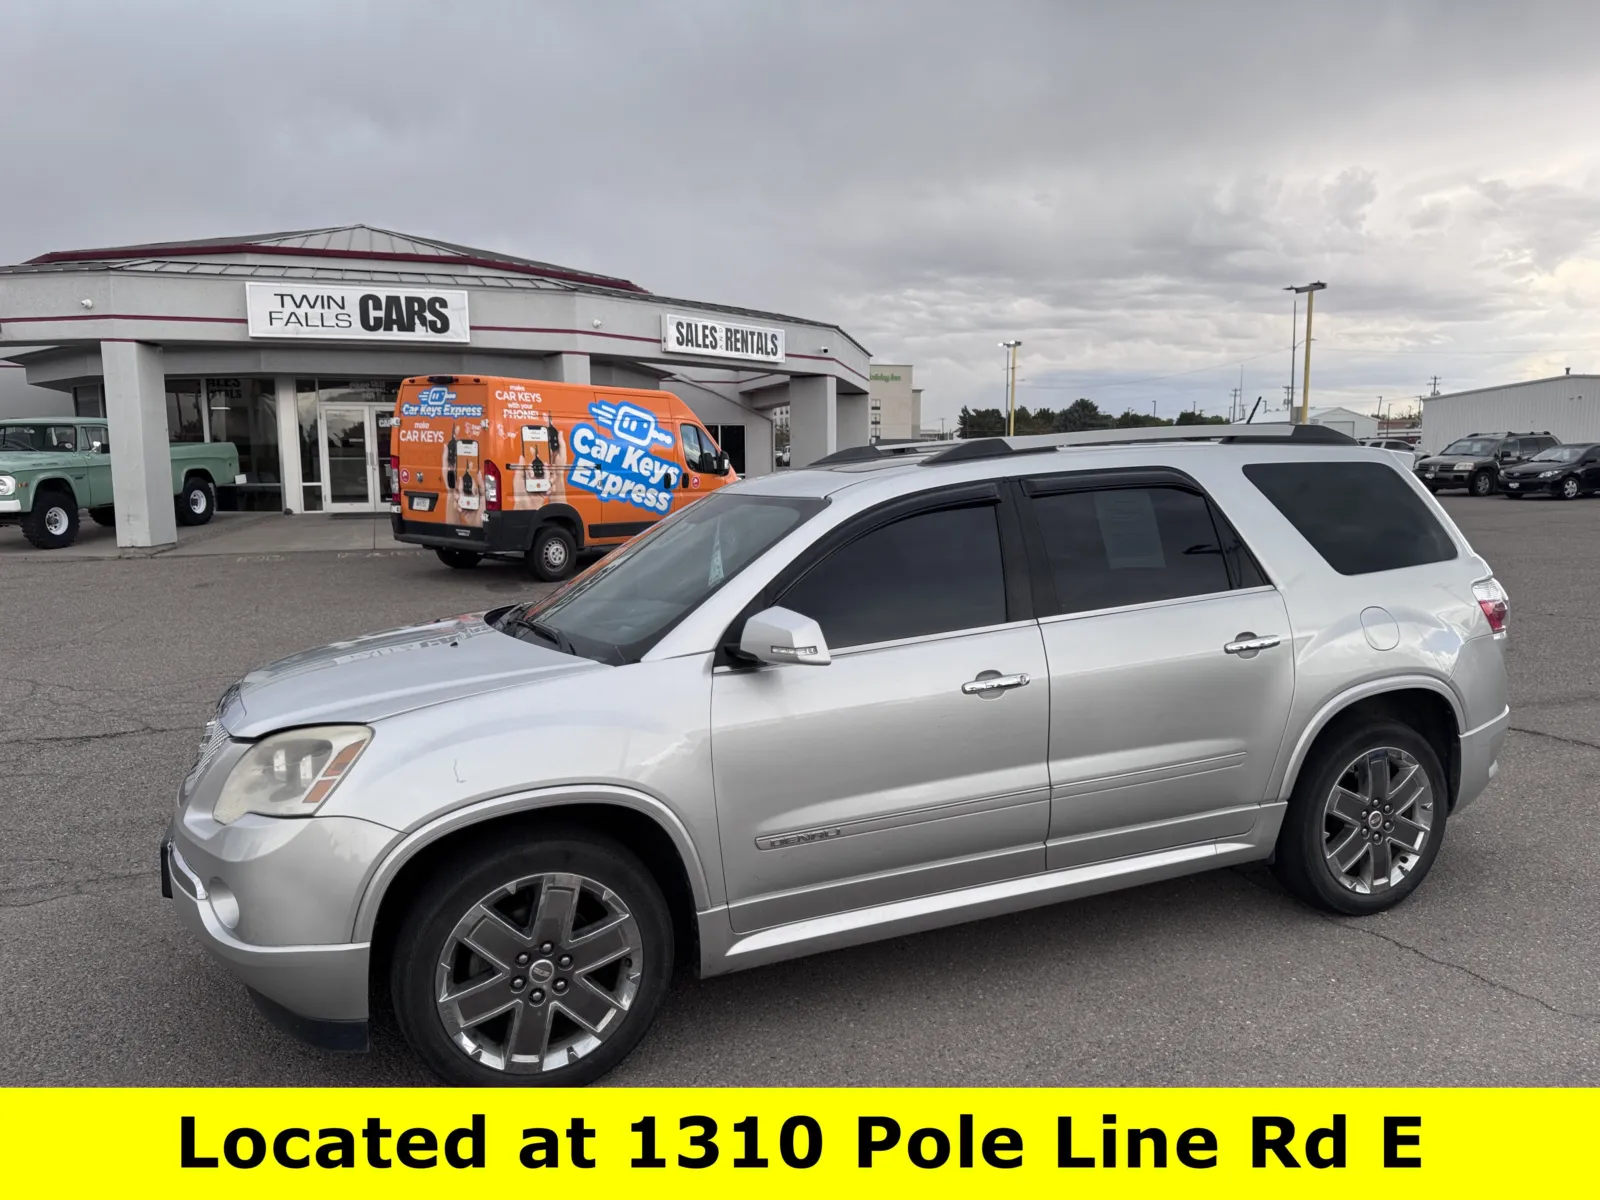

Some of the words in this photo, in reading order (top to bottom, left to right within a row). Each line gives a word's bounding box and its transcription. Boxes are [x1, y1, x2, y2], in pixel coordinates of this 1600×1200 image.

[273, 293, 346, 310] TWIN
[268, 310, 353, 329] FALLS
[359, 293, 450, 334] CARS
[675, 321, 718, 350] SALES
[725, 327, 778, 357] RENTALS
[495, 390, 517, 401] CAR
[517, 391, 542, 403] KEYS
[402, 403, 420, 416] Car
[420, 404, 442, 418] Keys
[443, 404, 482, 418] Express
[400, 430, 419, 442] CAR
[420, 431, 444, 443] KEYS
[573, 427, 621, 464] Car
[621, 445, 680, 485] Keys
[571, 457, 671, 511] Express
